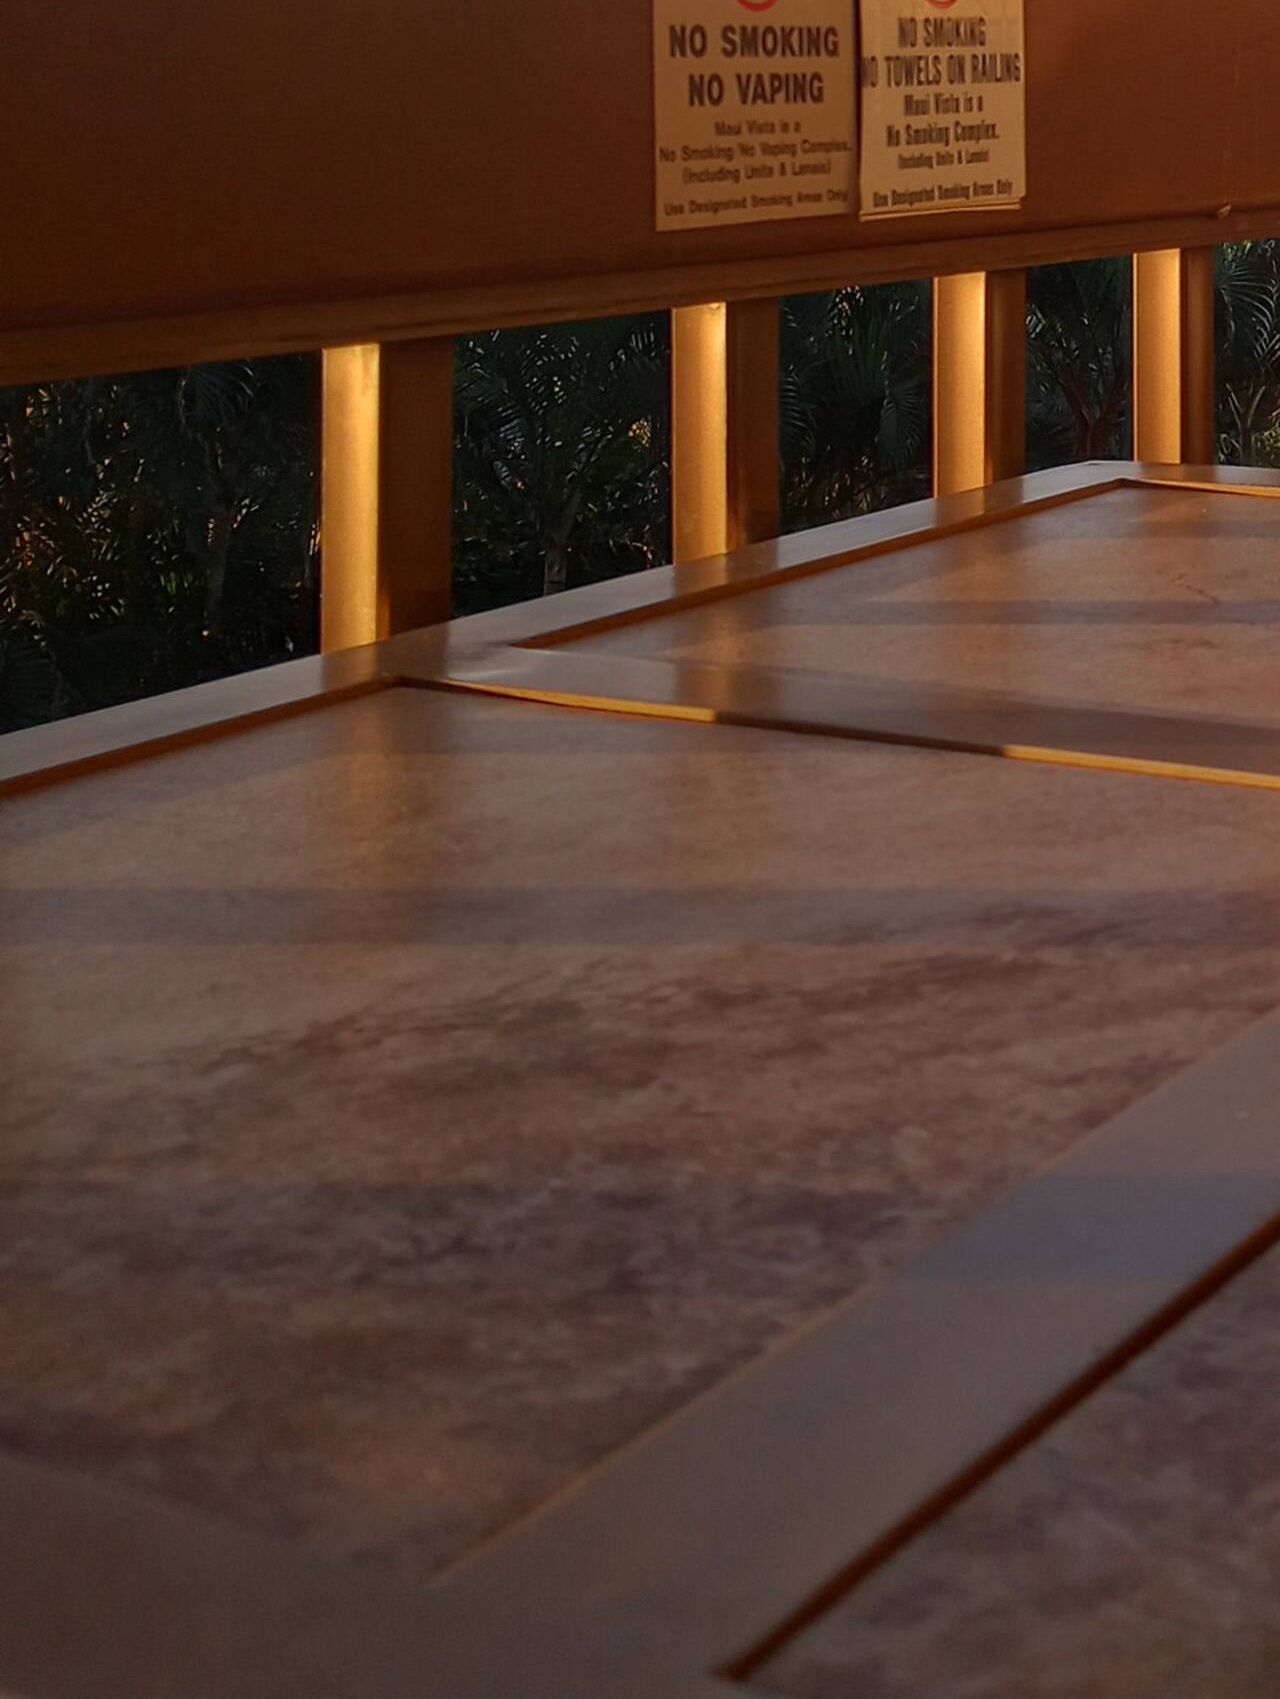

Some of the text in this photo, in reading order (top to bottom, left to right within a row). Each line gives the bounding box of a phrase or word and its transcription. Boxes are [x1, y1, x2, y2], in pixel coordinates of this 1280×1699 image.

[669, 24, 839, 58] NO SMOKING
[897, 17, 986, 48] NO SMOKING
[861, 52, 1021, 88] NO TOWELS ON RAILING
[688, 72, 824, 107] NO VAPING
[886, 125, 900, 147] No
[905, 123, 950, 147] Smoking
[659, 147, 677, 163] No
[681, 145, 734, 161] Smoking
